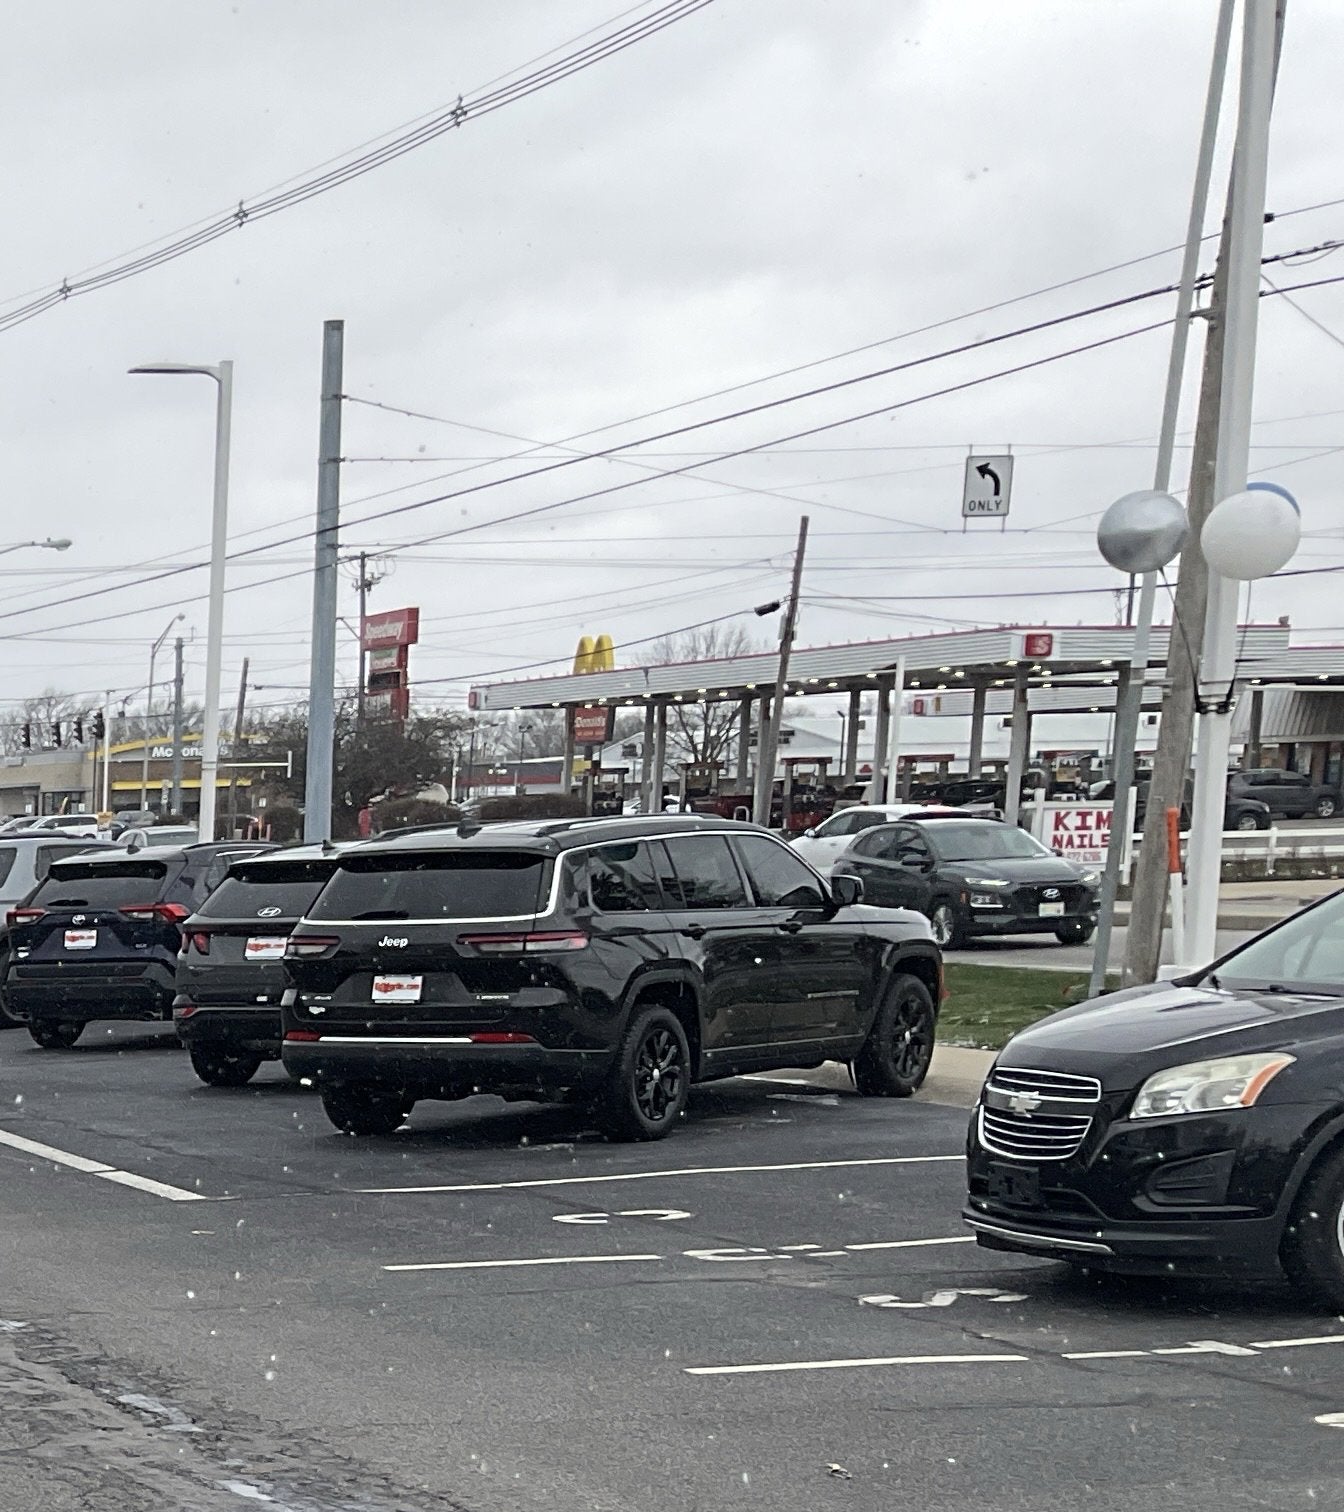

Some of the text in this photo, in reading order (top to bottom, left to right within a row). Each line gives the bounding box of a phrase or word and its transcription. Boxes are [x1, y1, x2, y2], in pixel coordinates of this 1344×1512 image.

[968, 499, 1002, 512] ONLY
[1053, 811, 1113, 831] KIM
[1052, 834, 1109, 848] NAILS
[378, 936, 409, 948] Jeep
